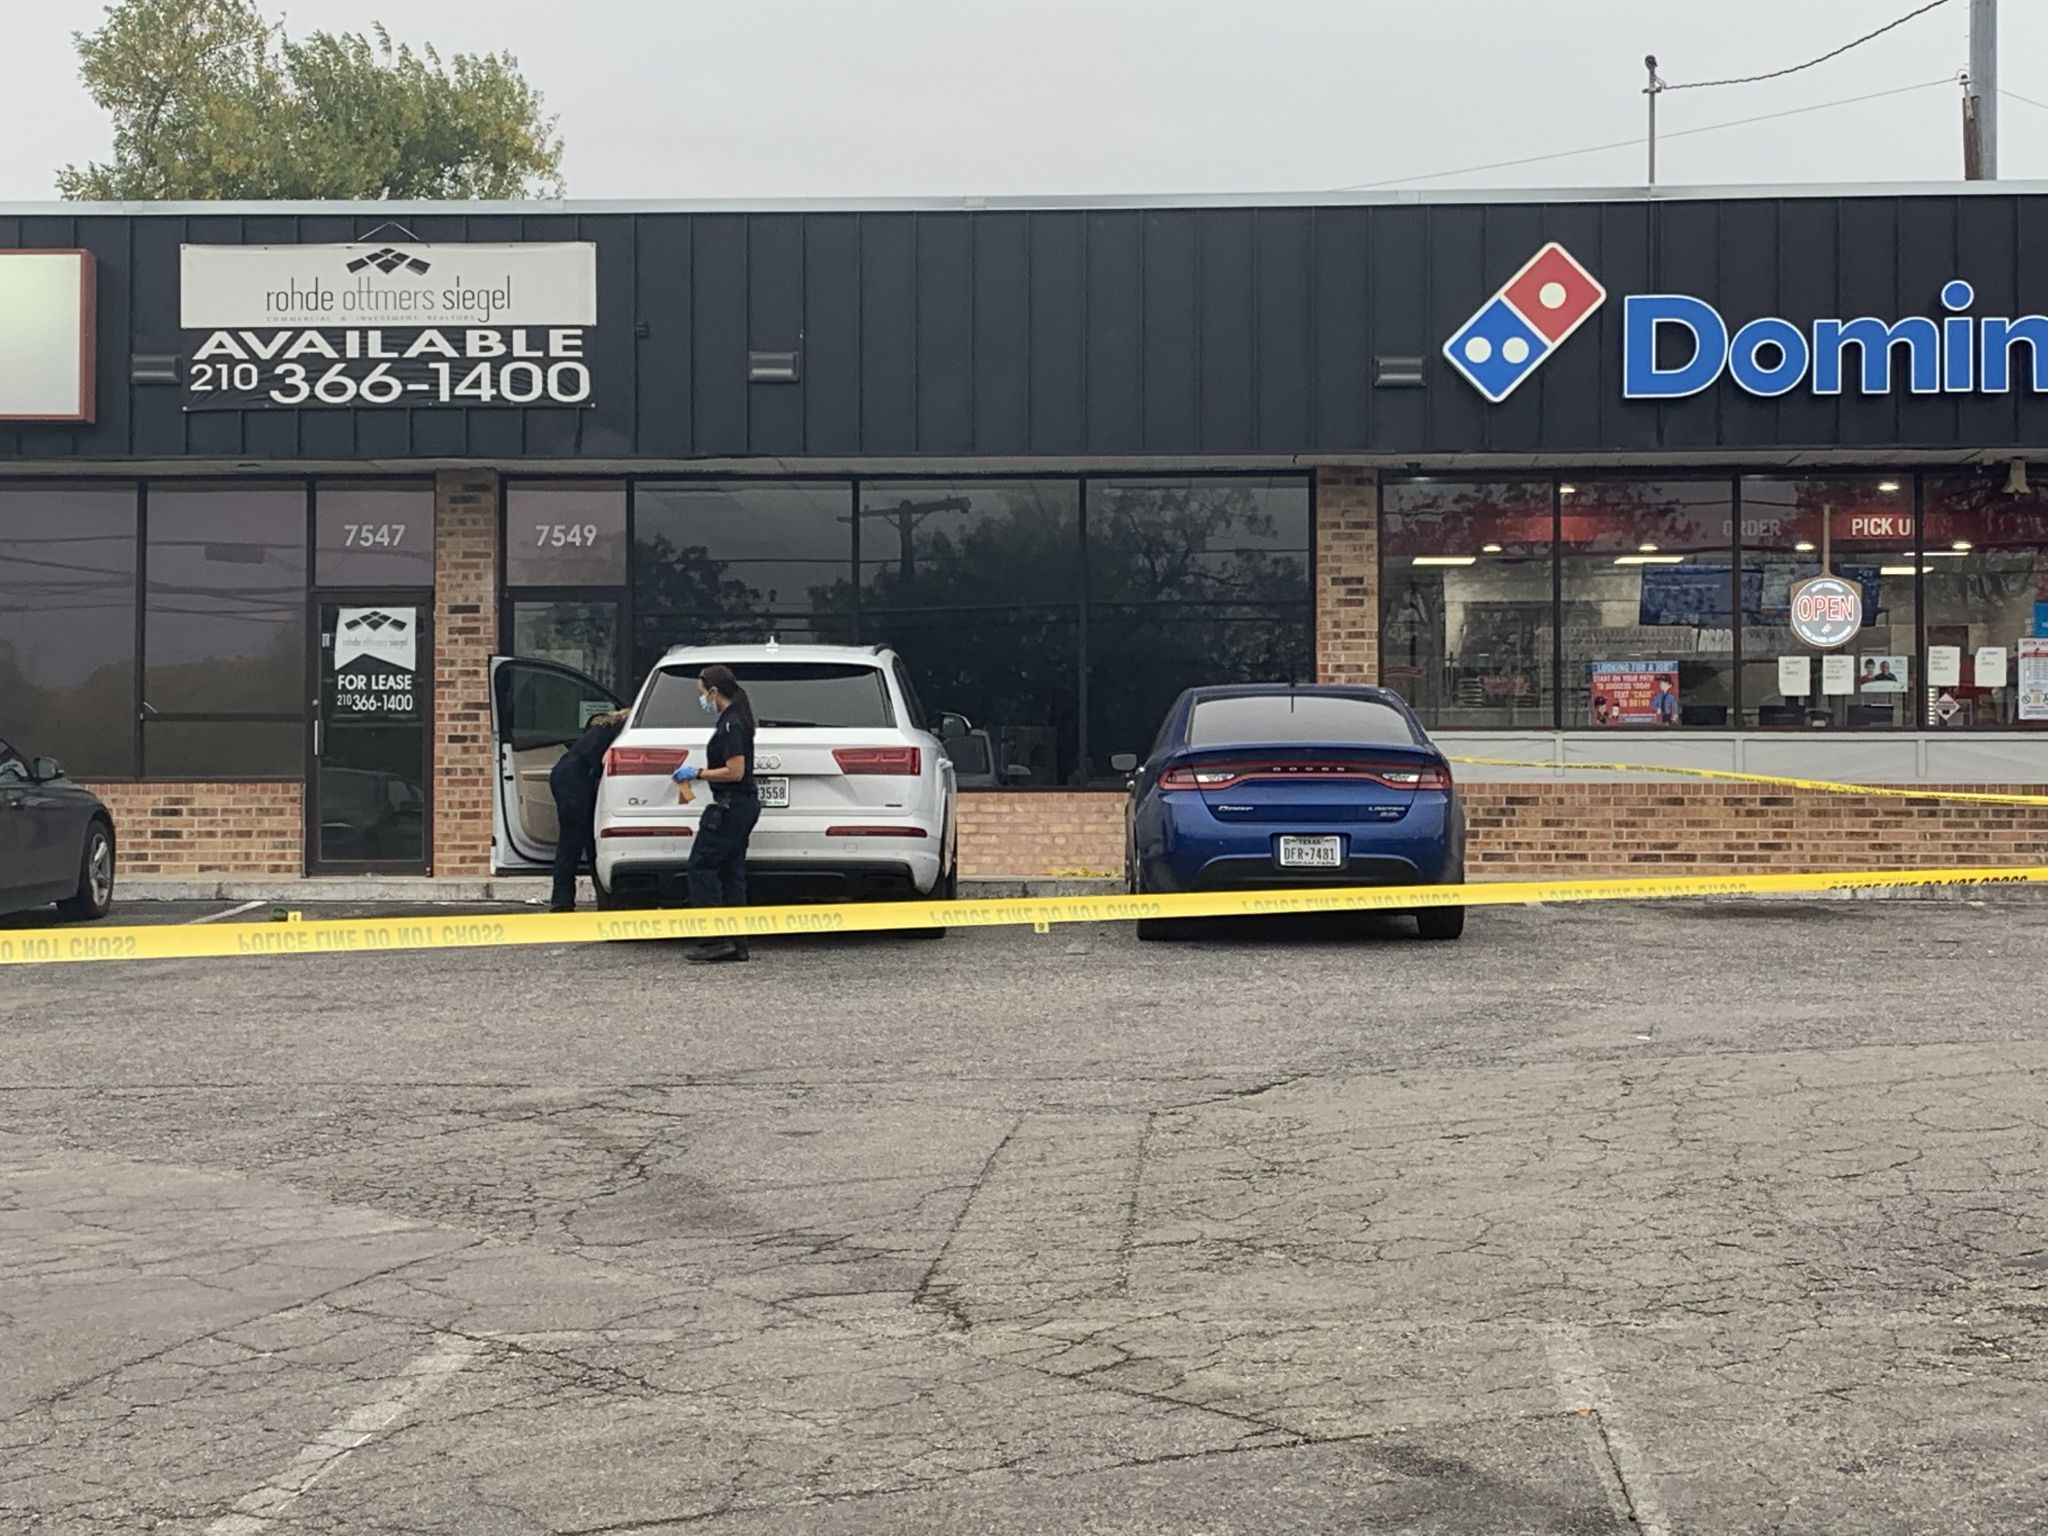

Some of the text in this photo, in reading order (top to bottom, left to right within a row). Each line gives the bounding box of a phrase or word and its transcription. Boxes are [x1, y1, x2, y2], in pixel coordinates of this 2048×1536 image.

[266, 275, 511, 323] rohde ottmers siegel
[192, 328, 583, 361] AVAILABLE
[1623, 280, 2048, 398] Domin
[189, 361, 591, 404] 210 366-1400
[343, 524, 406, 548] 7547
[535, 524, 598, 548] 7549
[1851, 517, 1915, 537] PICK U
[1797, 594, 1854, 622] OPEN
[337, 674, 412, 691] FOR LEASE
[352, 694, 414, 712] 366-1400
[628, 797, 648, 806] Q7
